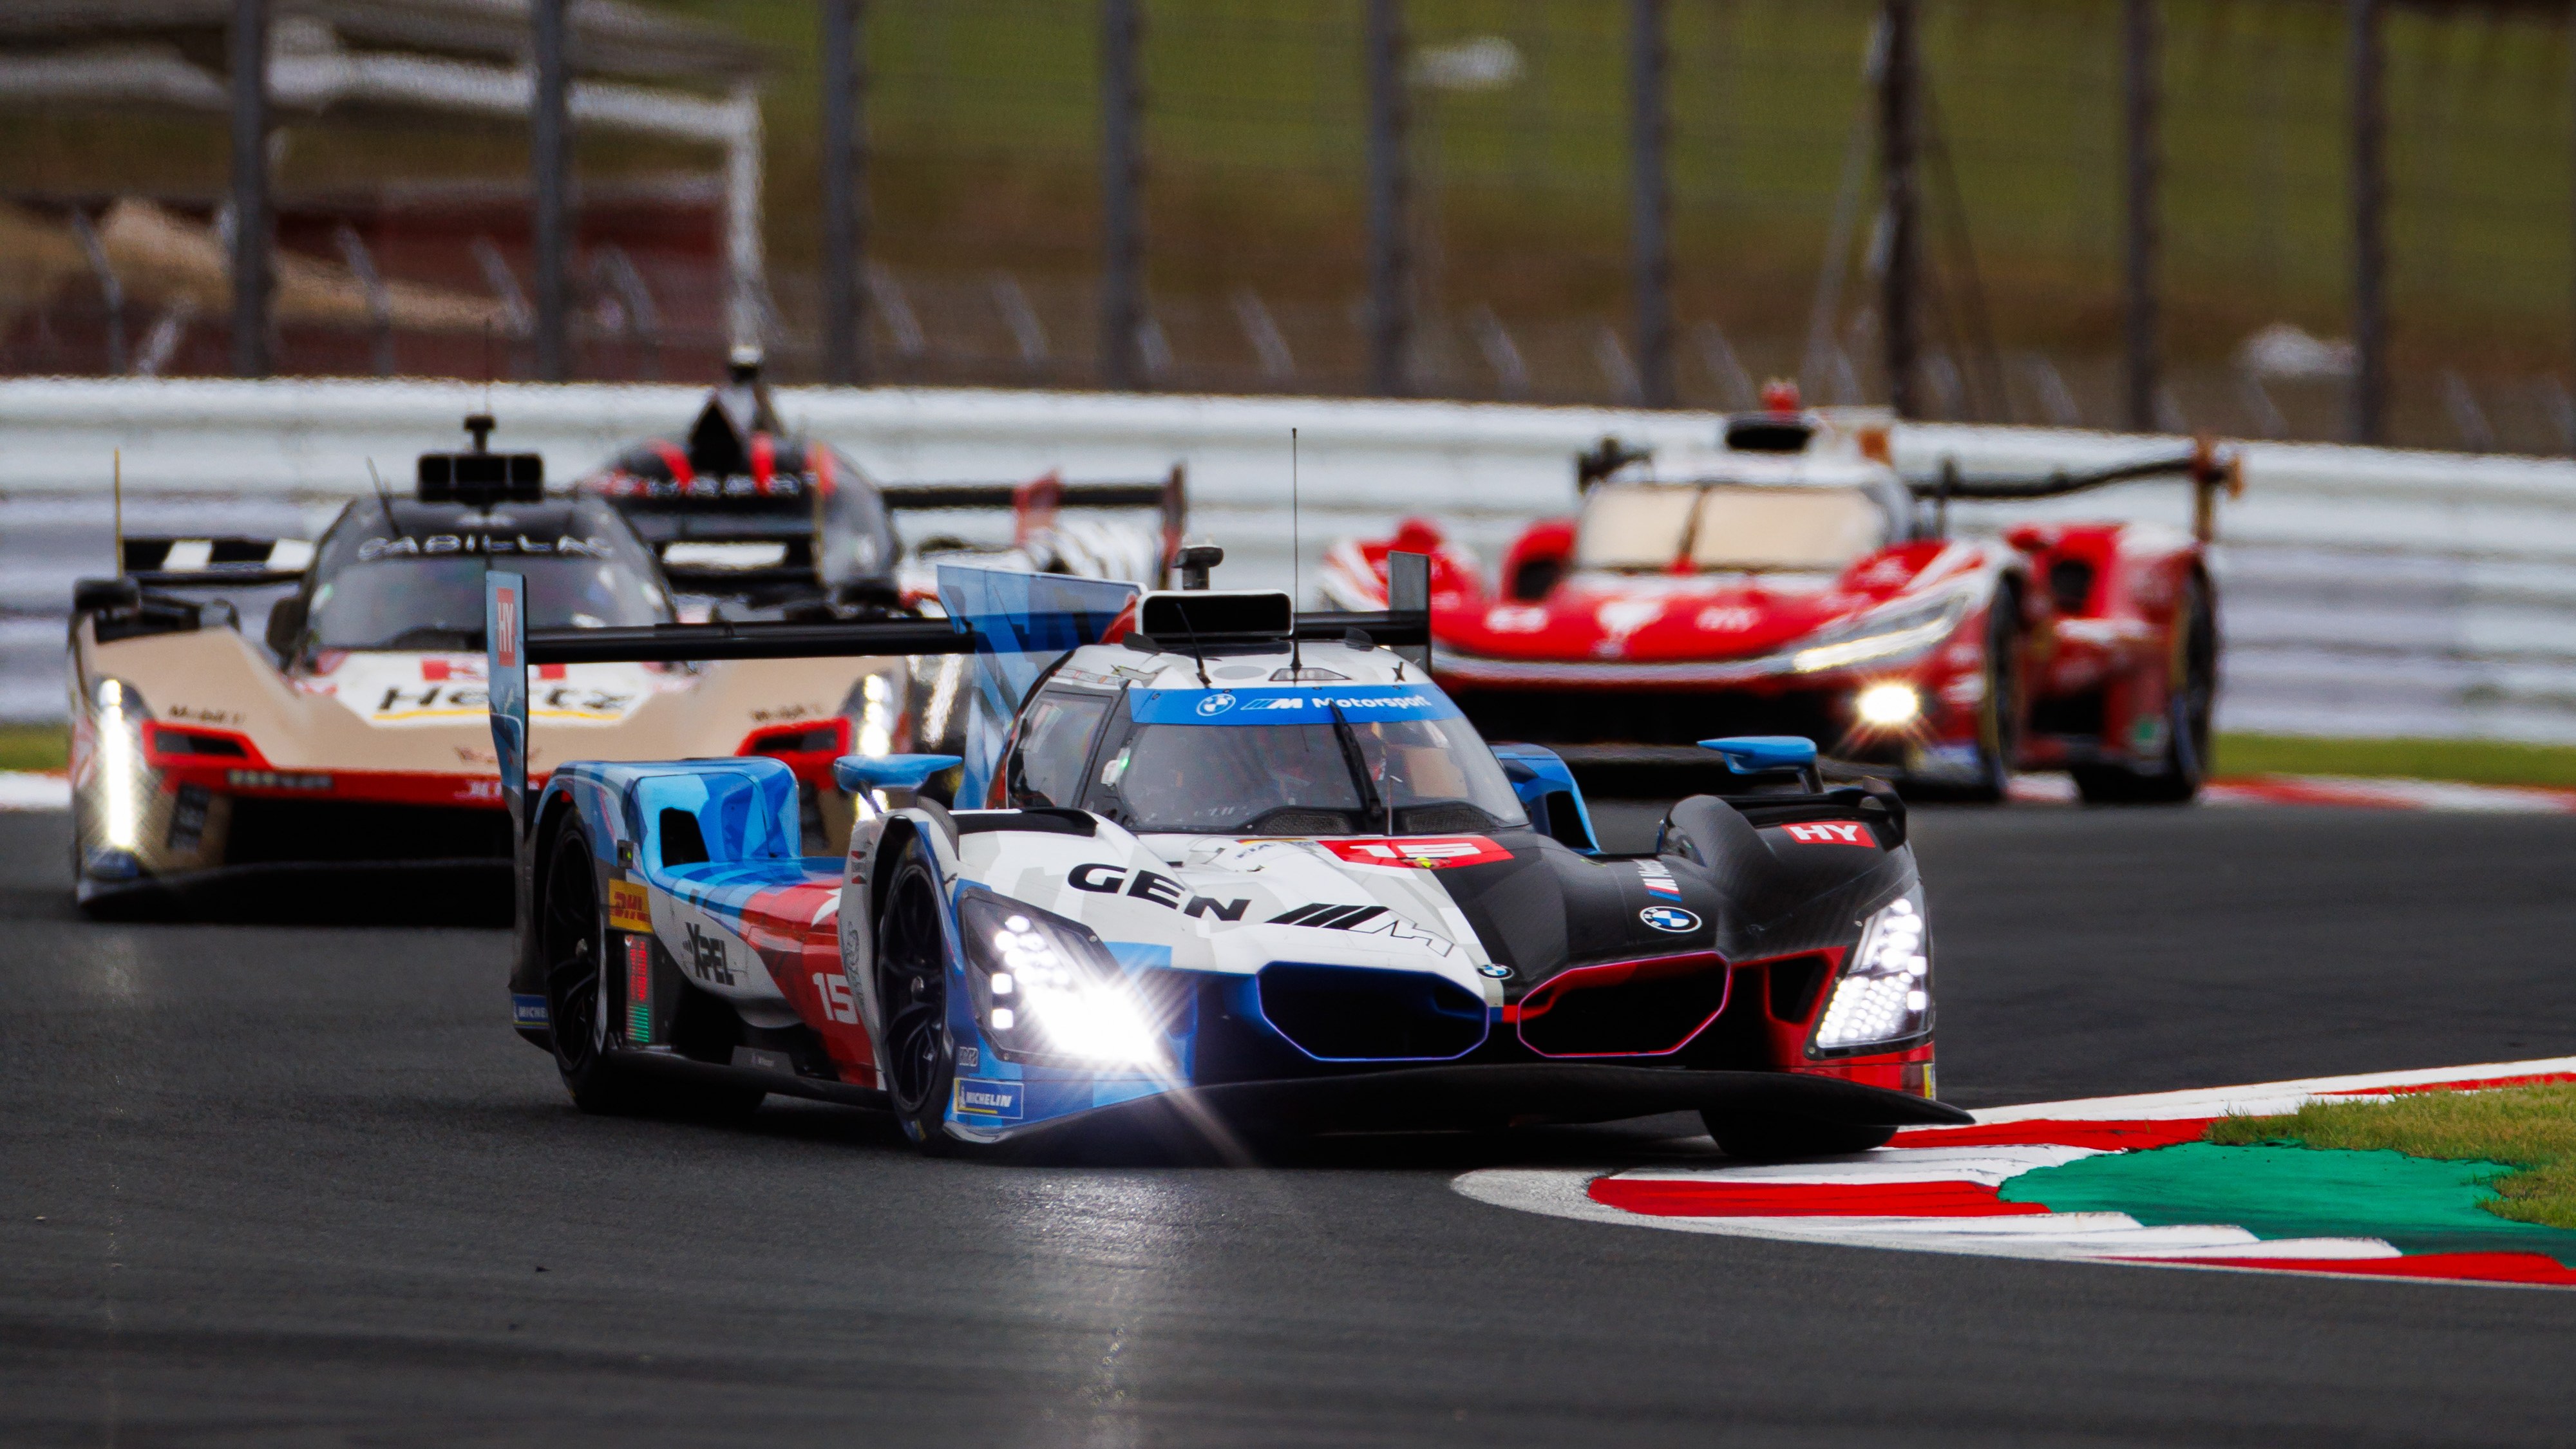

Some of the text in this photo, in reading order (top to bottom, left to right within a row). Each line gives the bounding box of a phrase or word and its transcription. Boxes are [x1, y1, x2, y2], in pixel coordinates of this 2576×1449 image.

[497, 601, 514, 652] HY
[378, 685, 635, 710] Hetz
[1312, 695, 1434, 709] Motorsport
[1788, 824, 1857, 842] HY
[1349, 843, 1482, 858] 15
[612, 890, 649, 921] DHL
[1067, 862, 1251, 921] GEN
[684, 921, 735, 987] XPEL
[811, 972, 860, 1025] 15
[966, 1091, 1013, 1108] MICHELIN
